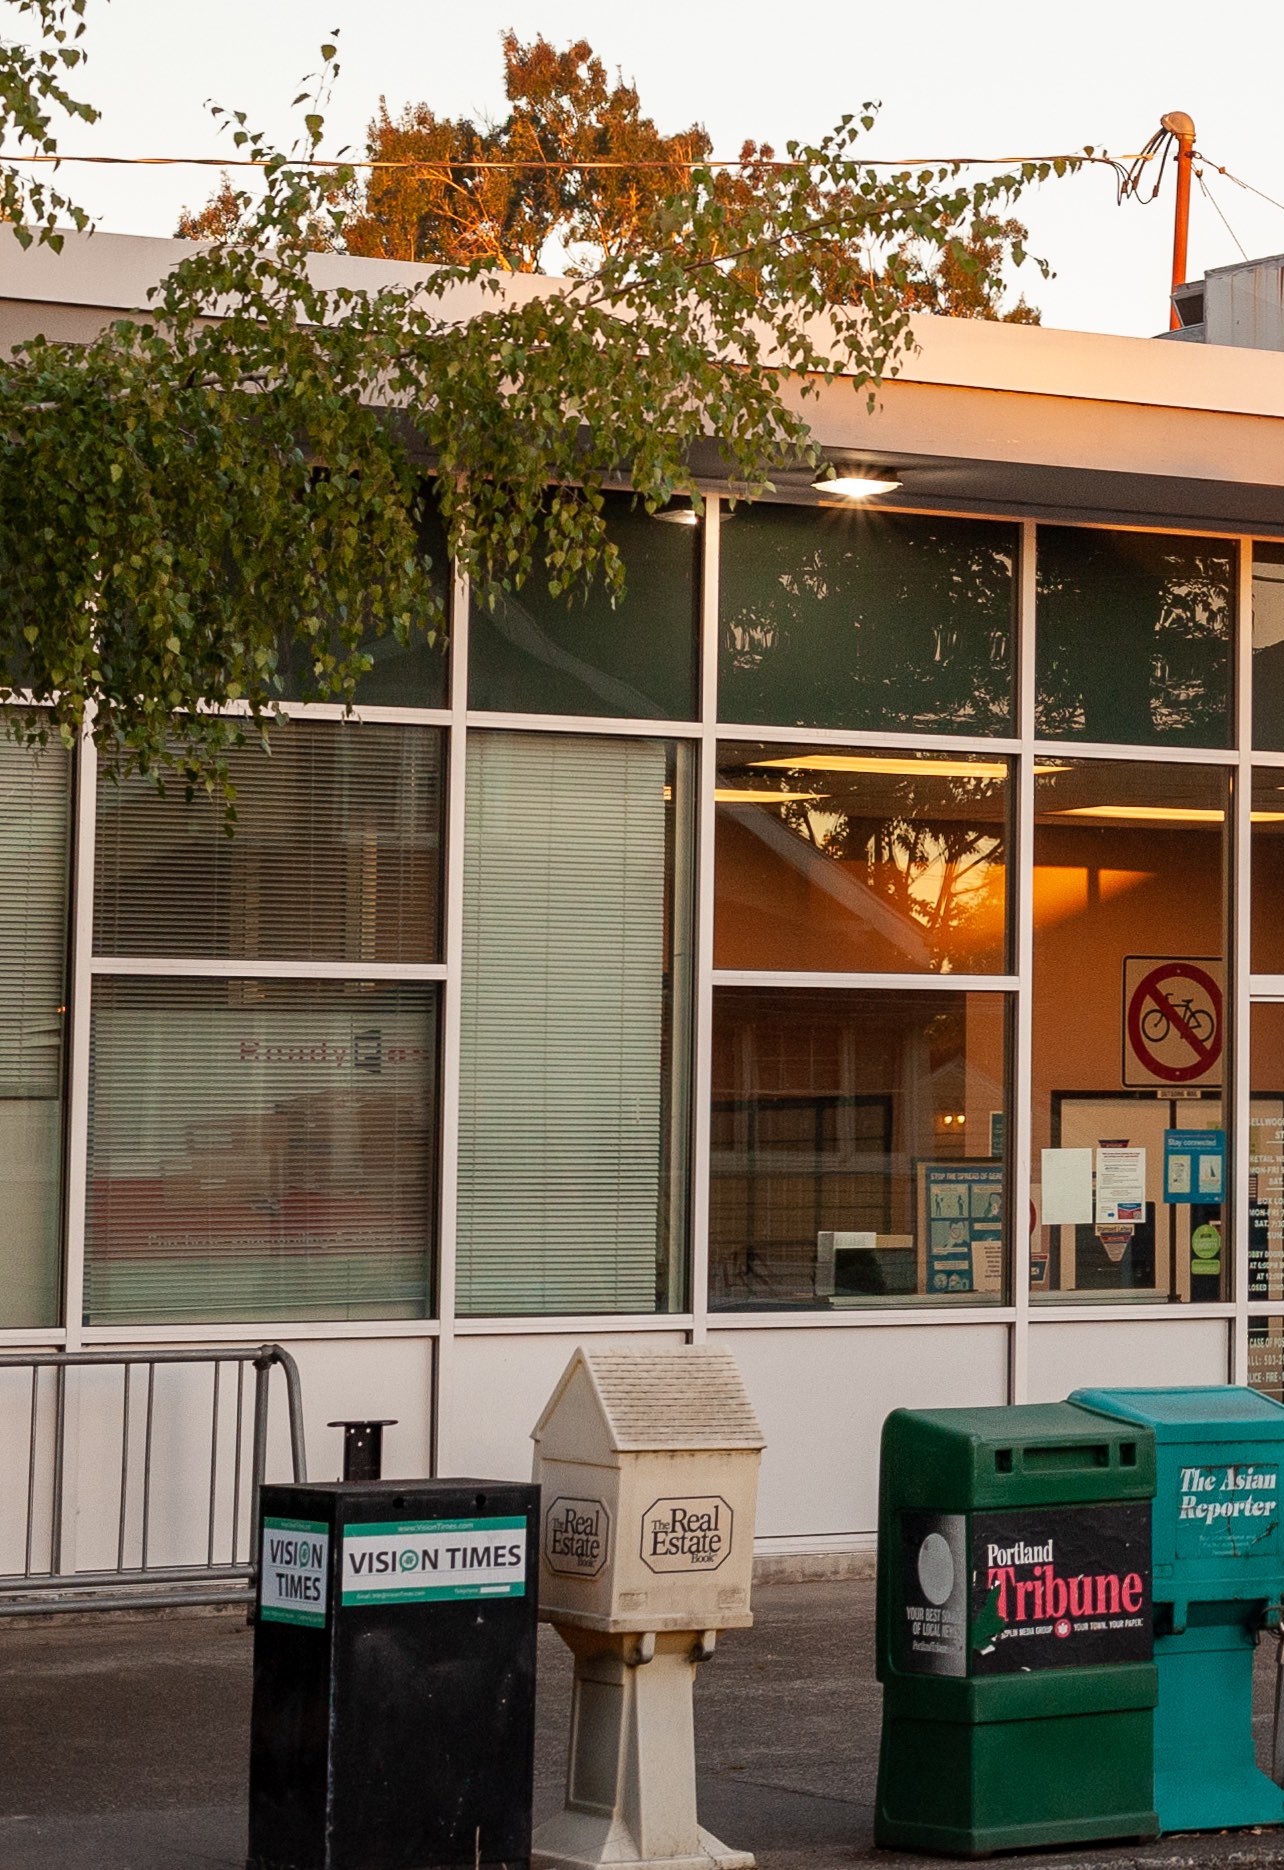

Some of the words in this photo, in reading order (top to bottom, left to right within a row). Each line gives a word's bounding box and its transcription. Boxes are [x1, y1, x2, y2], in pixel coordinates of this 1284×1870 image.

[1248, 1250, 1264, 1258] OBBY
[1248, 1283, 1267, 1291] LOSED
[1249, 1337, 1264, 1348] CASE
[1265, 1337, 1272, 1348] OF
[1247, 1354, 1262, 1366] ALL:
[1266, 1371, 1279, 1383] FIRE
[1180, 1467, 1216, 1492] The
[1220, 1467, 1276, 1491] Asian
[651, 1519, 671, 1533] The
[670, 1505, 720, 1533] Real
[1179, 1494, 1277, 1525] Reporter
[551, 1517, 564, 1530] The
[564, 1508, 600, 1536] Real
[270, 1539, 323, 1568] VISION
[551, 1530, 600, 1558] Estate
[650, 1532, 721, 1556] Estate
[987, 1539, 1053, 1566] Portland
[349, 1549, 440, 1574] VISION
[446, 1544, 522, 1569] TIMES
[691, 1552, 715, 1564] Book
[275, 1572, 321, 1601] TIMES
[987, 1565, 1143, 1621] Tribune
[906, 1606, 924, 1620] YOUR
[925, 1608, 941, 1622] BEST
[912, 1621, 921, 1635] OF
[922, 1622, 940, 1637] LOCAL
[1019, 1627, 1034, 1636] MEDIA
[1035, 1625, 1053, 1635] GROUP
[1074, 1622, 1089, 1631] YOUR
[1108, 1620, 1124, 1629] YOUR
